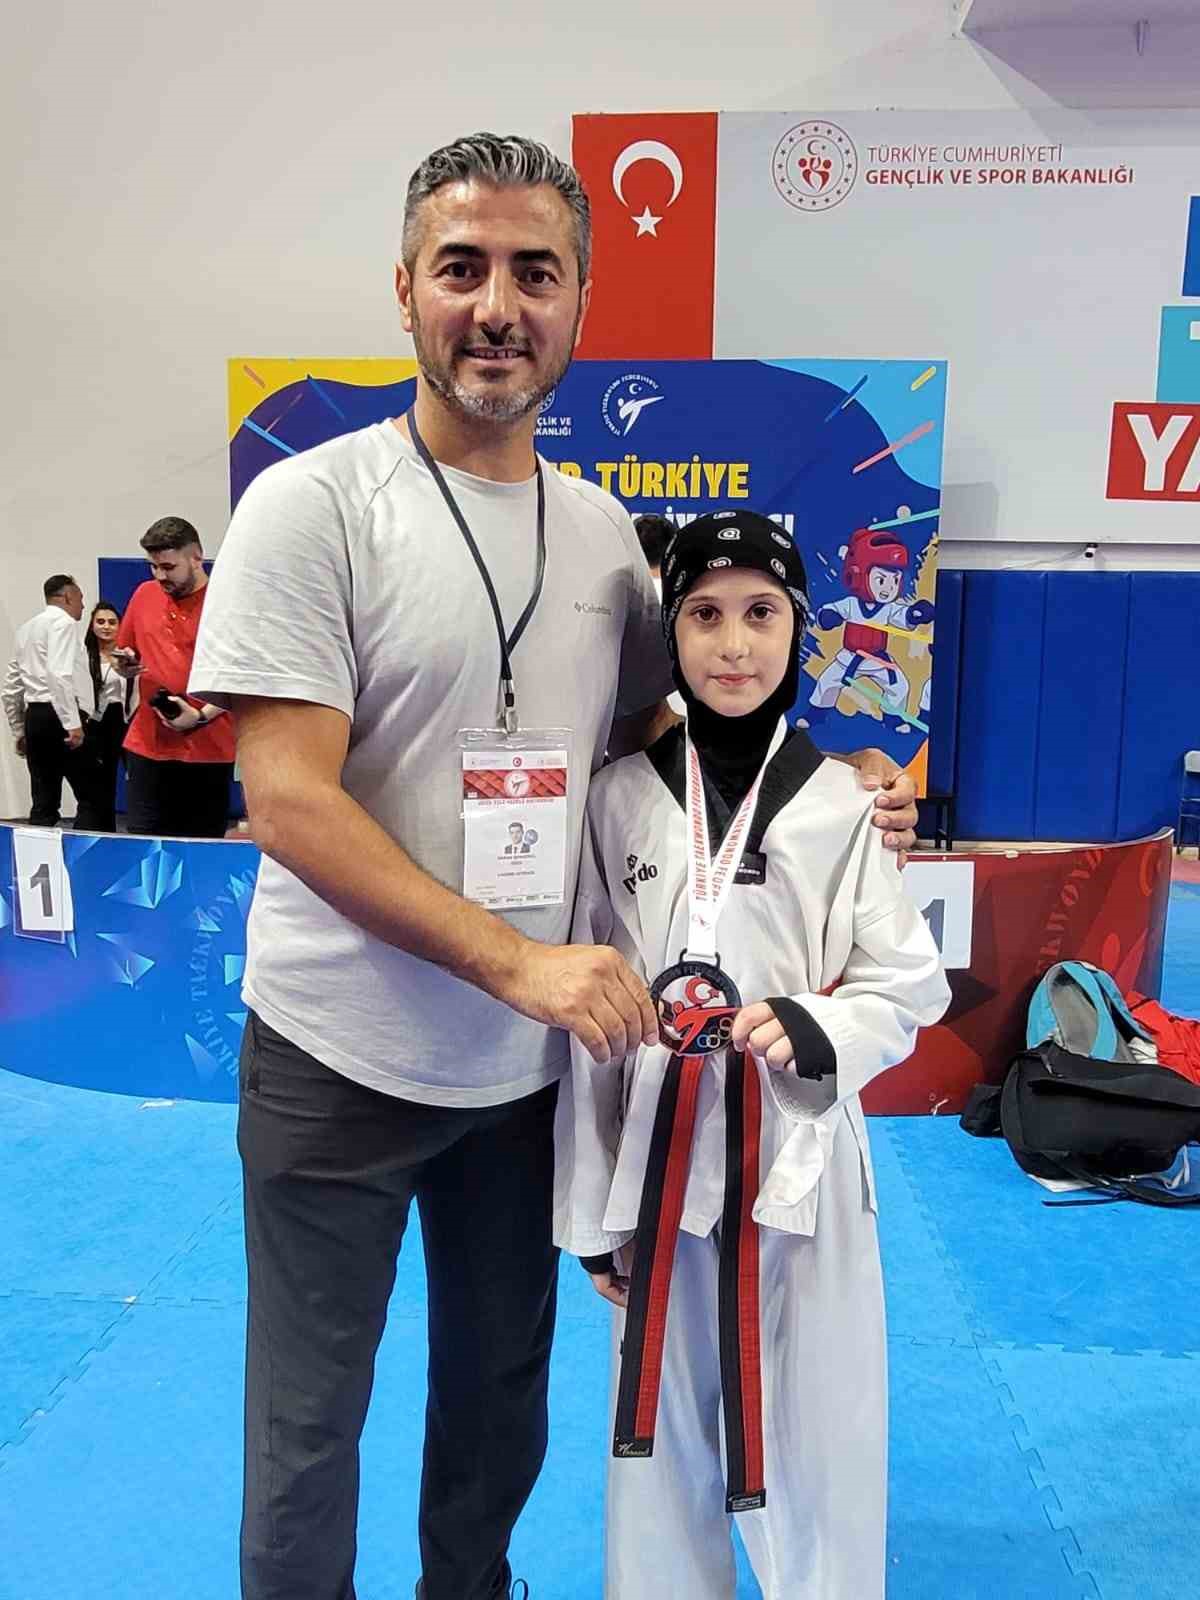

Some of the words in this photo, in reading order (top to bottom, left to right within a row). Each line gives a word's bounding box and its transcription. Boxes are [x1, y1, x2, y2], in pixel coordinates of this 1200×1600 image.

[867, 144, 937, 163] TÜRKİYE
[943, 143, 1063, 162] CUMHURİYETİ
[865, 166, 944, 188] GENÇLİK
[950, 169, 972, 184] VE
[977, 168, 1026, 184] SPOR
[1032, 165, 1134, 184] BAKANLIĞI
[560, 416, 572, 426] VE
[595, 454, 750, 498] TÜRKİYE
[30, 864, 53, 917] 1
[920, 899, 945, 954] 1
